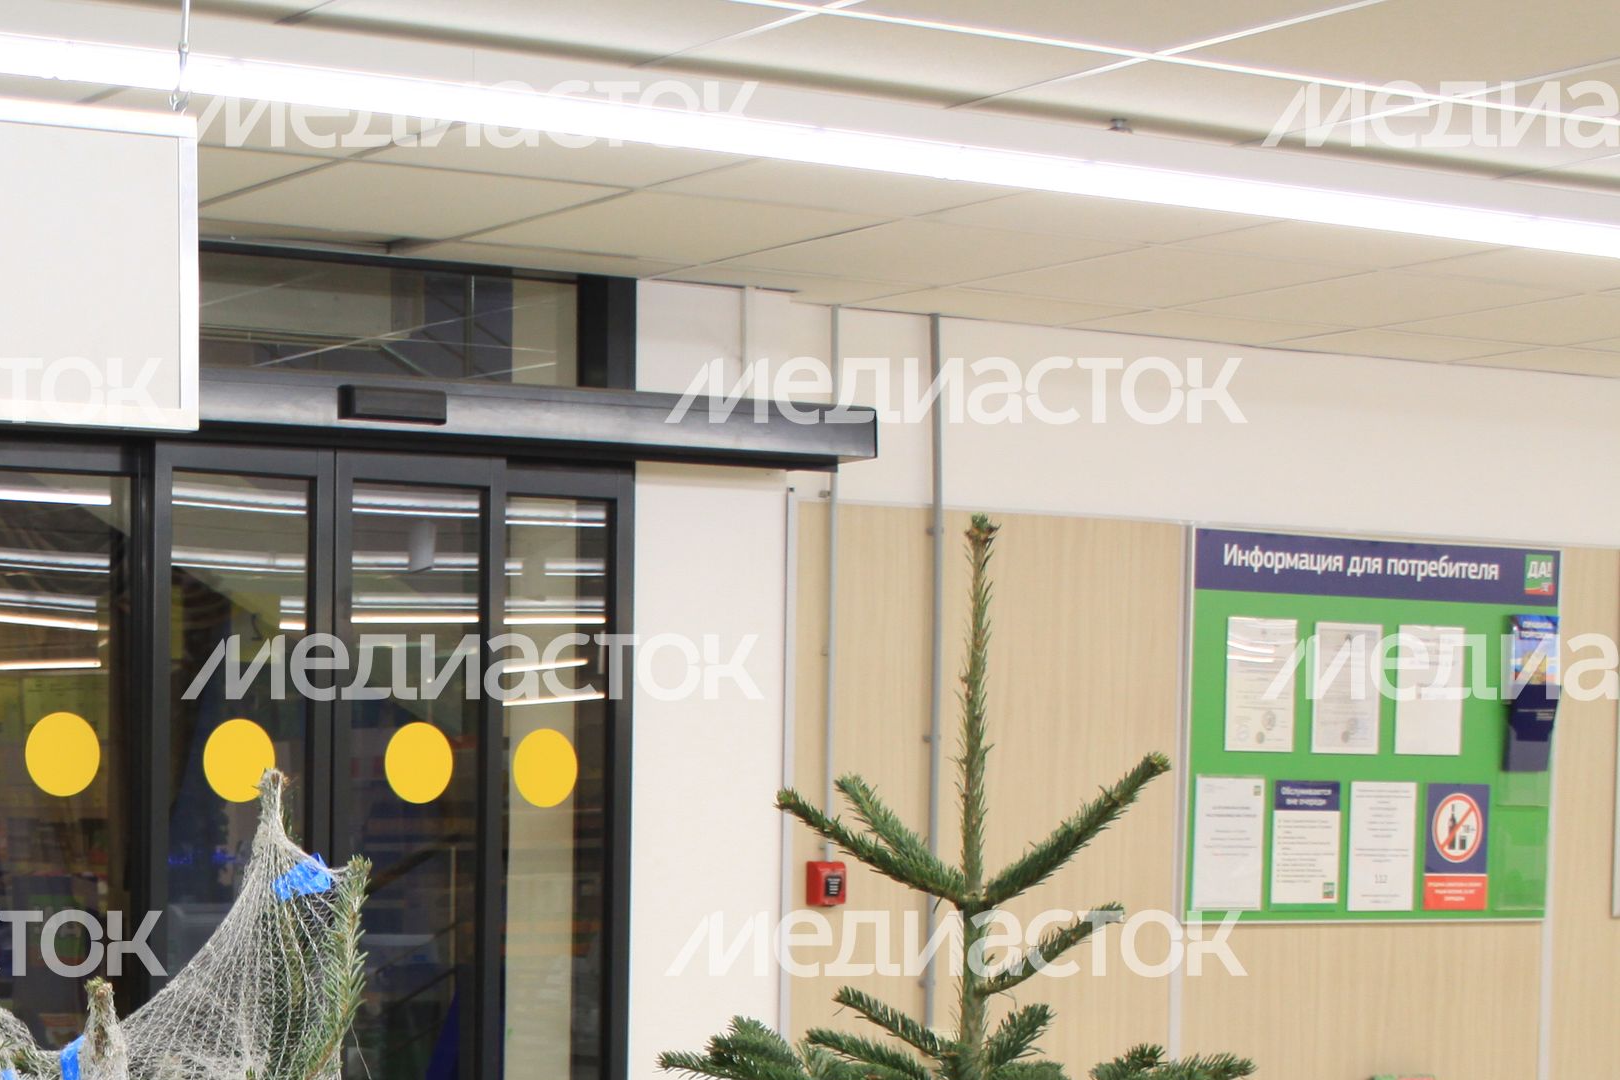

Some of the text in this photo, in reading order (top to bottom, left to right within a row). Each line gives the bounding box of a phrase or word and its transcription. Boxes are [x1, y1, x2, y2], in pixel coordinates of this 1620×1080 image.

[1223, 543, 1500, 582] Информация для потребителя
[1527, 560, 1553, 579] ДА!
